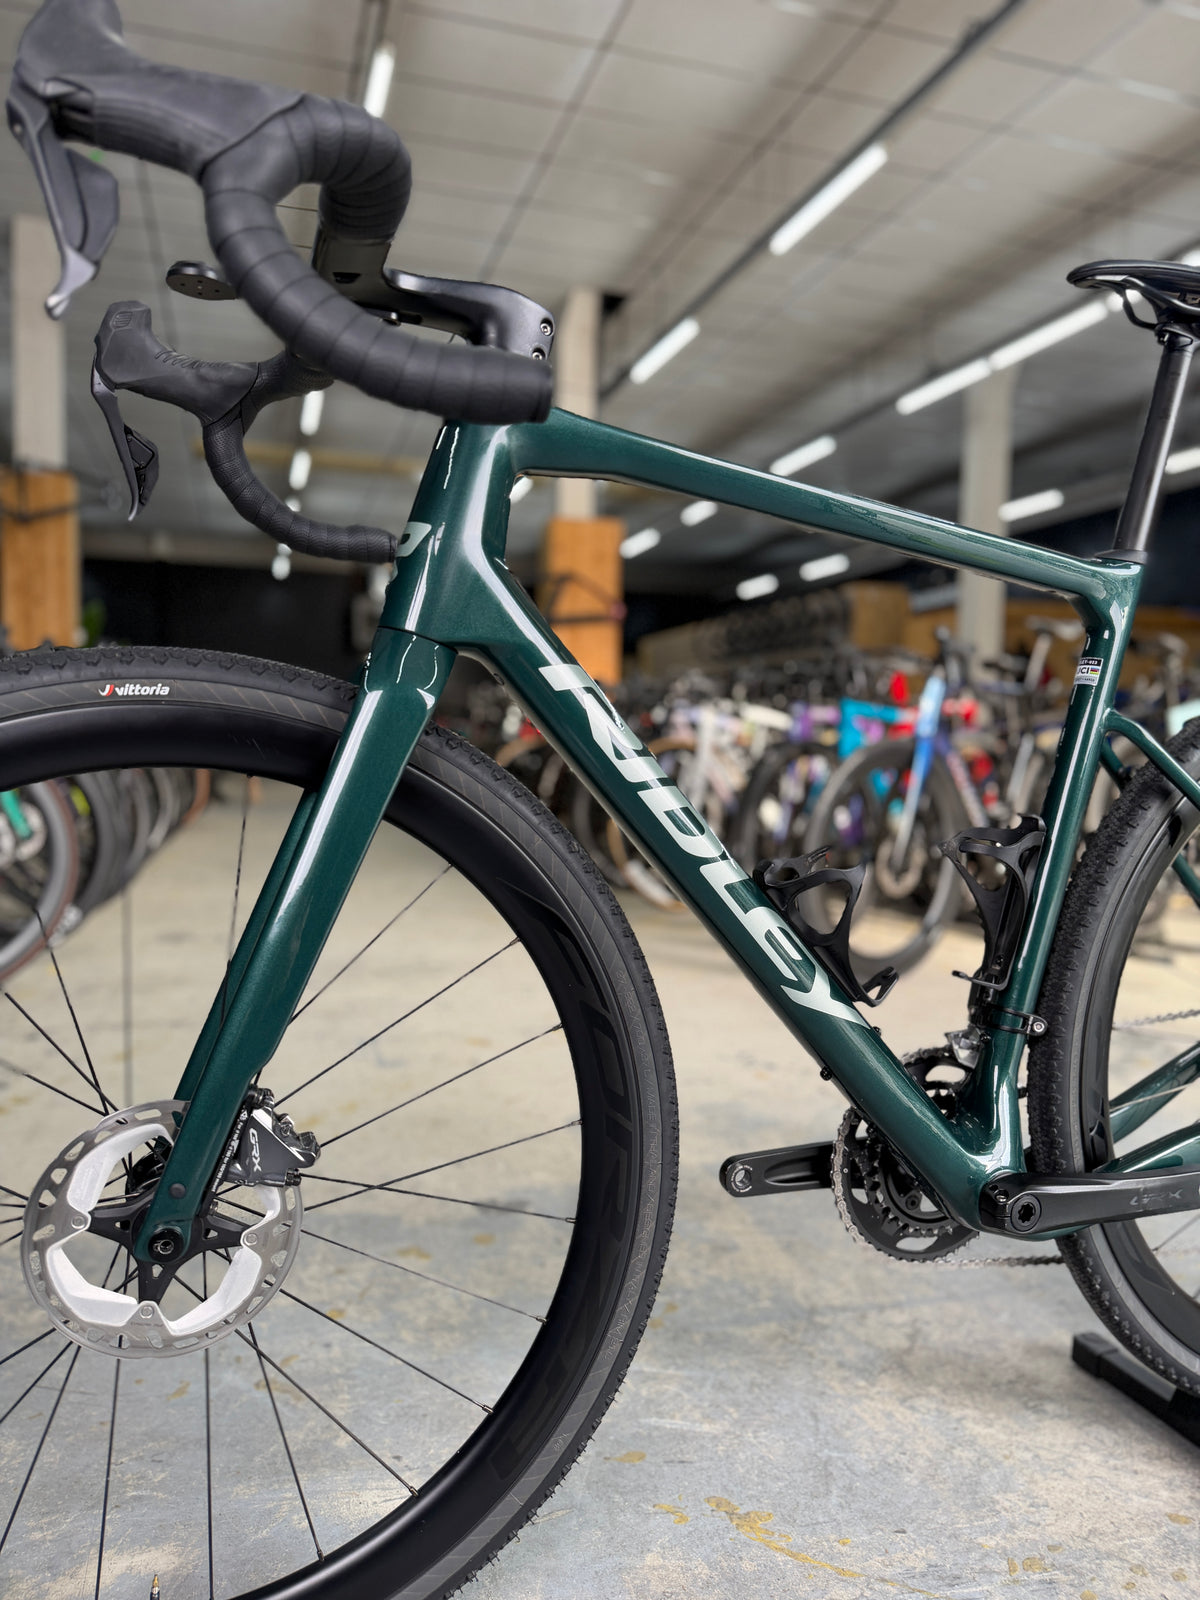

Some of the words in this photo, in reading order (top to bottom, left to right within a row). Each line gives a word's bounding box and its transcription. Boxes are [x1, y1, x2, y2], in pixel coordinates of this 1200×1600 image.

[115, 683, 170, 696] vittoria
[538, 664, 871, 1029] RIDLEY
[249, 1128, 262, 1172] GRX
